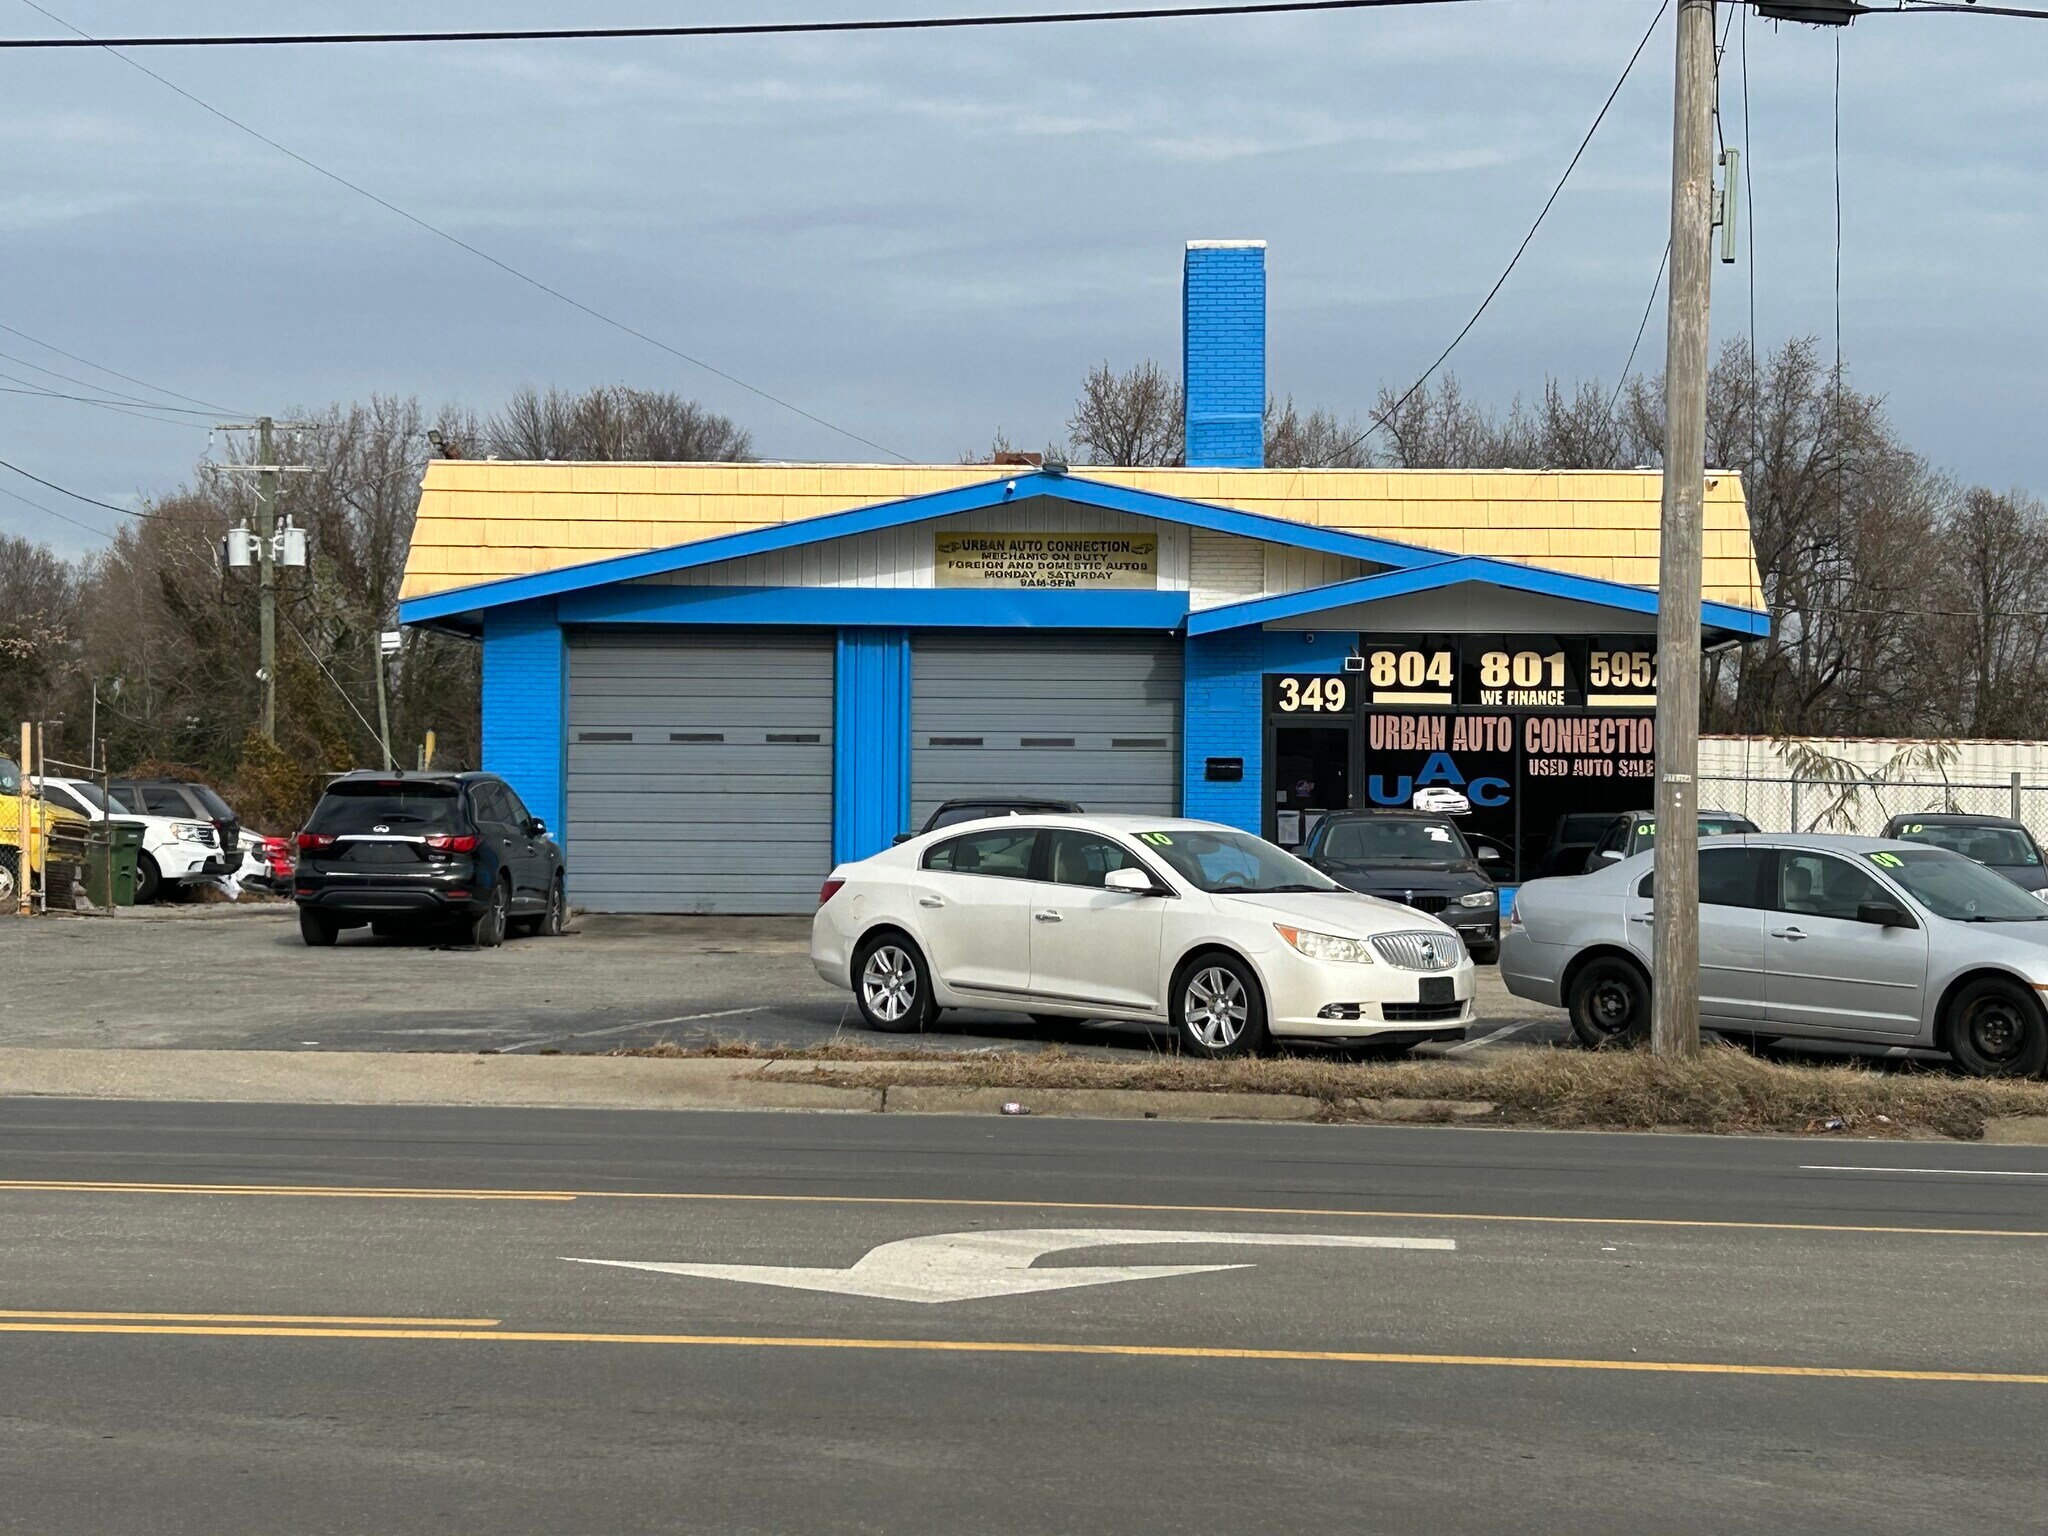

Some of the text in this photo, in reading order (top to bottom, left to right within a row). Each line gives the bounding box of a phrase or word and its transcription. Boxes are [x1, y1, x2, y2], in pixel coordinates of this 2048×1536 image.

[962, 539, 1130, 553] URBAN AUTO CONNECTION
[981, 552, 1108, 562] MECHANIC ON DUTY
[948, 560, 1148, 571] FOREIGN AND DOMESTIC AUTOS
[984, 570, 1037, 579] MONDAY
[1047, 571, 1113, 580] SATURDAY
[1370, 651, 1657, 687] 804 801 595
[1279, 677, 1346, 712] 349
[1480, 689, 1565, 706] WE FINANCE
[1370, 715, 1653, 753] URBAN AUTO CONNECTIO
[1529, 759, 1568, 776] USED
[1572, 759, 1614, 777] AUTO
[1902, 824, 1923, 834] 10
[1141, 833, 1174, 846] 10
[1869, 852, 1905, 868] 09
